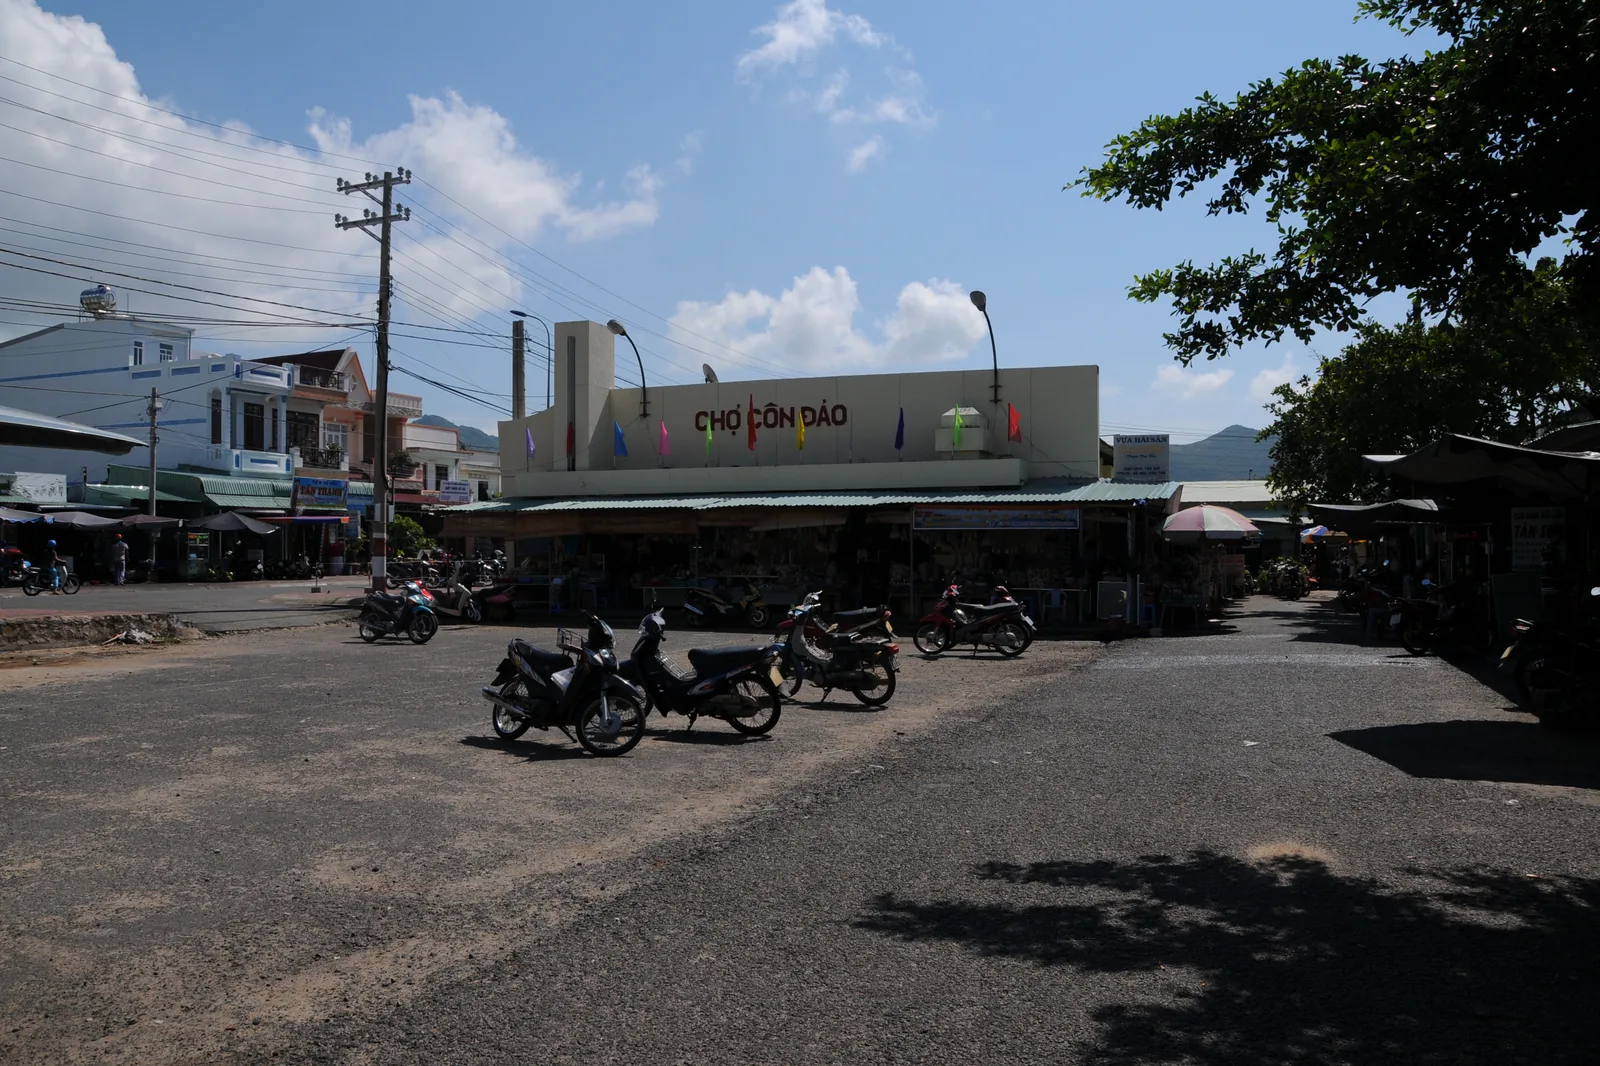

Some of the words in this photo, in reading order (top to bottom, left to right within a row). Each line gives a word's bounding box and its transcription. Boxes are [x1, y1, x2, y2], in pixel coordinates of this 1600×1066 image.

[695, 404, 741, 436] CHỢ
[747, 402, 795, 430] CÔN
[800, 399, 848, 428] ĐẢO
